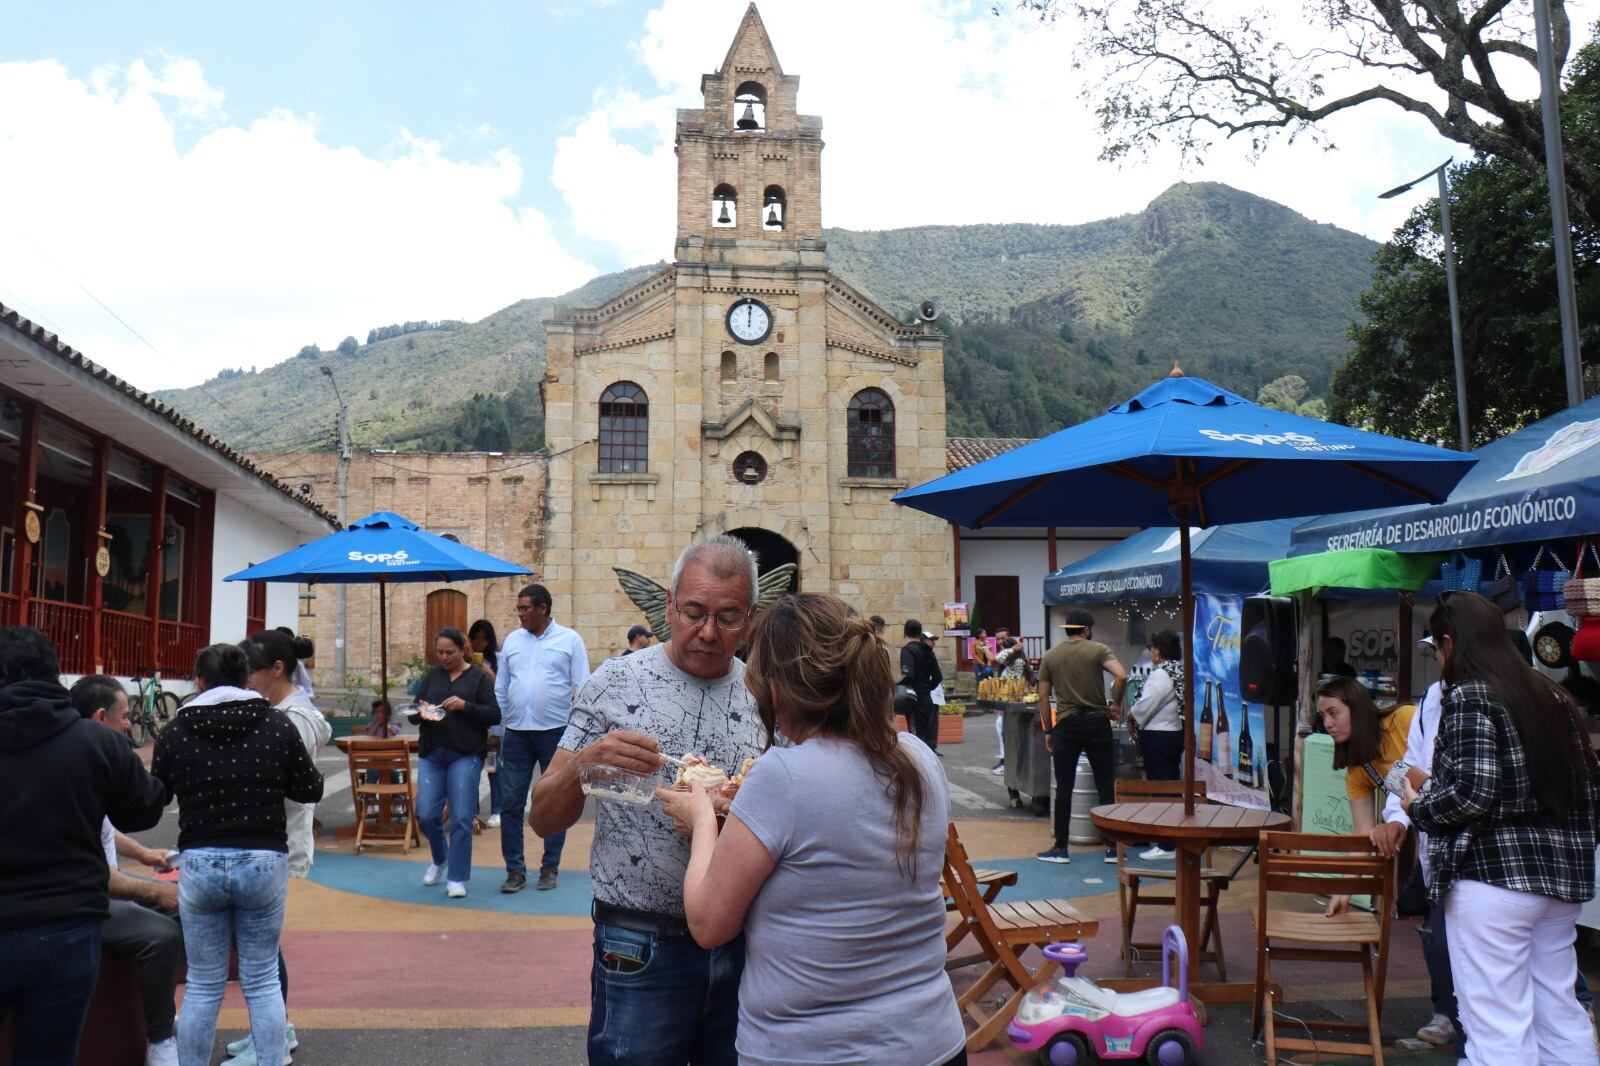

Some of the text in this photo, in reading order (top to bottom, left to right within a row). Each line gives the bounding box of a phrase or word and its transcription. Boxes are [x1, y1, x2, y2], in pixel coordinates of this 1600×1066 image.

[1198, 429, 1316, 445] Sopó
[1294, 444, 1356, 452] DESTINO
[1327, 495, 1576, 551] SECRETARÍA DE DESARROLLO ECONÓMICO
[348, 550, 408, 563] Sopó
[1060, 579, 1086, 596] SECRETARÍA
[1087, 582, 1095, 594] DE
[1127, 571, 1162, 590] ECONÓMICO
[1350, 629, 1398, 656] SOP
